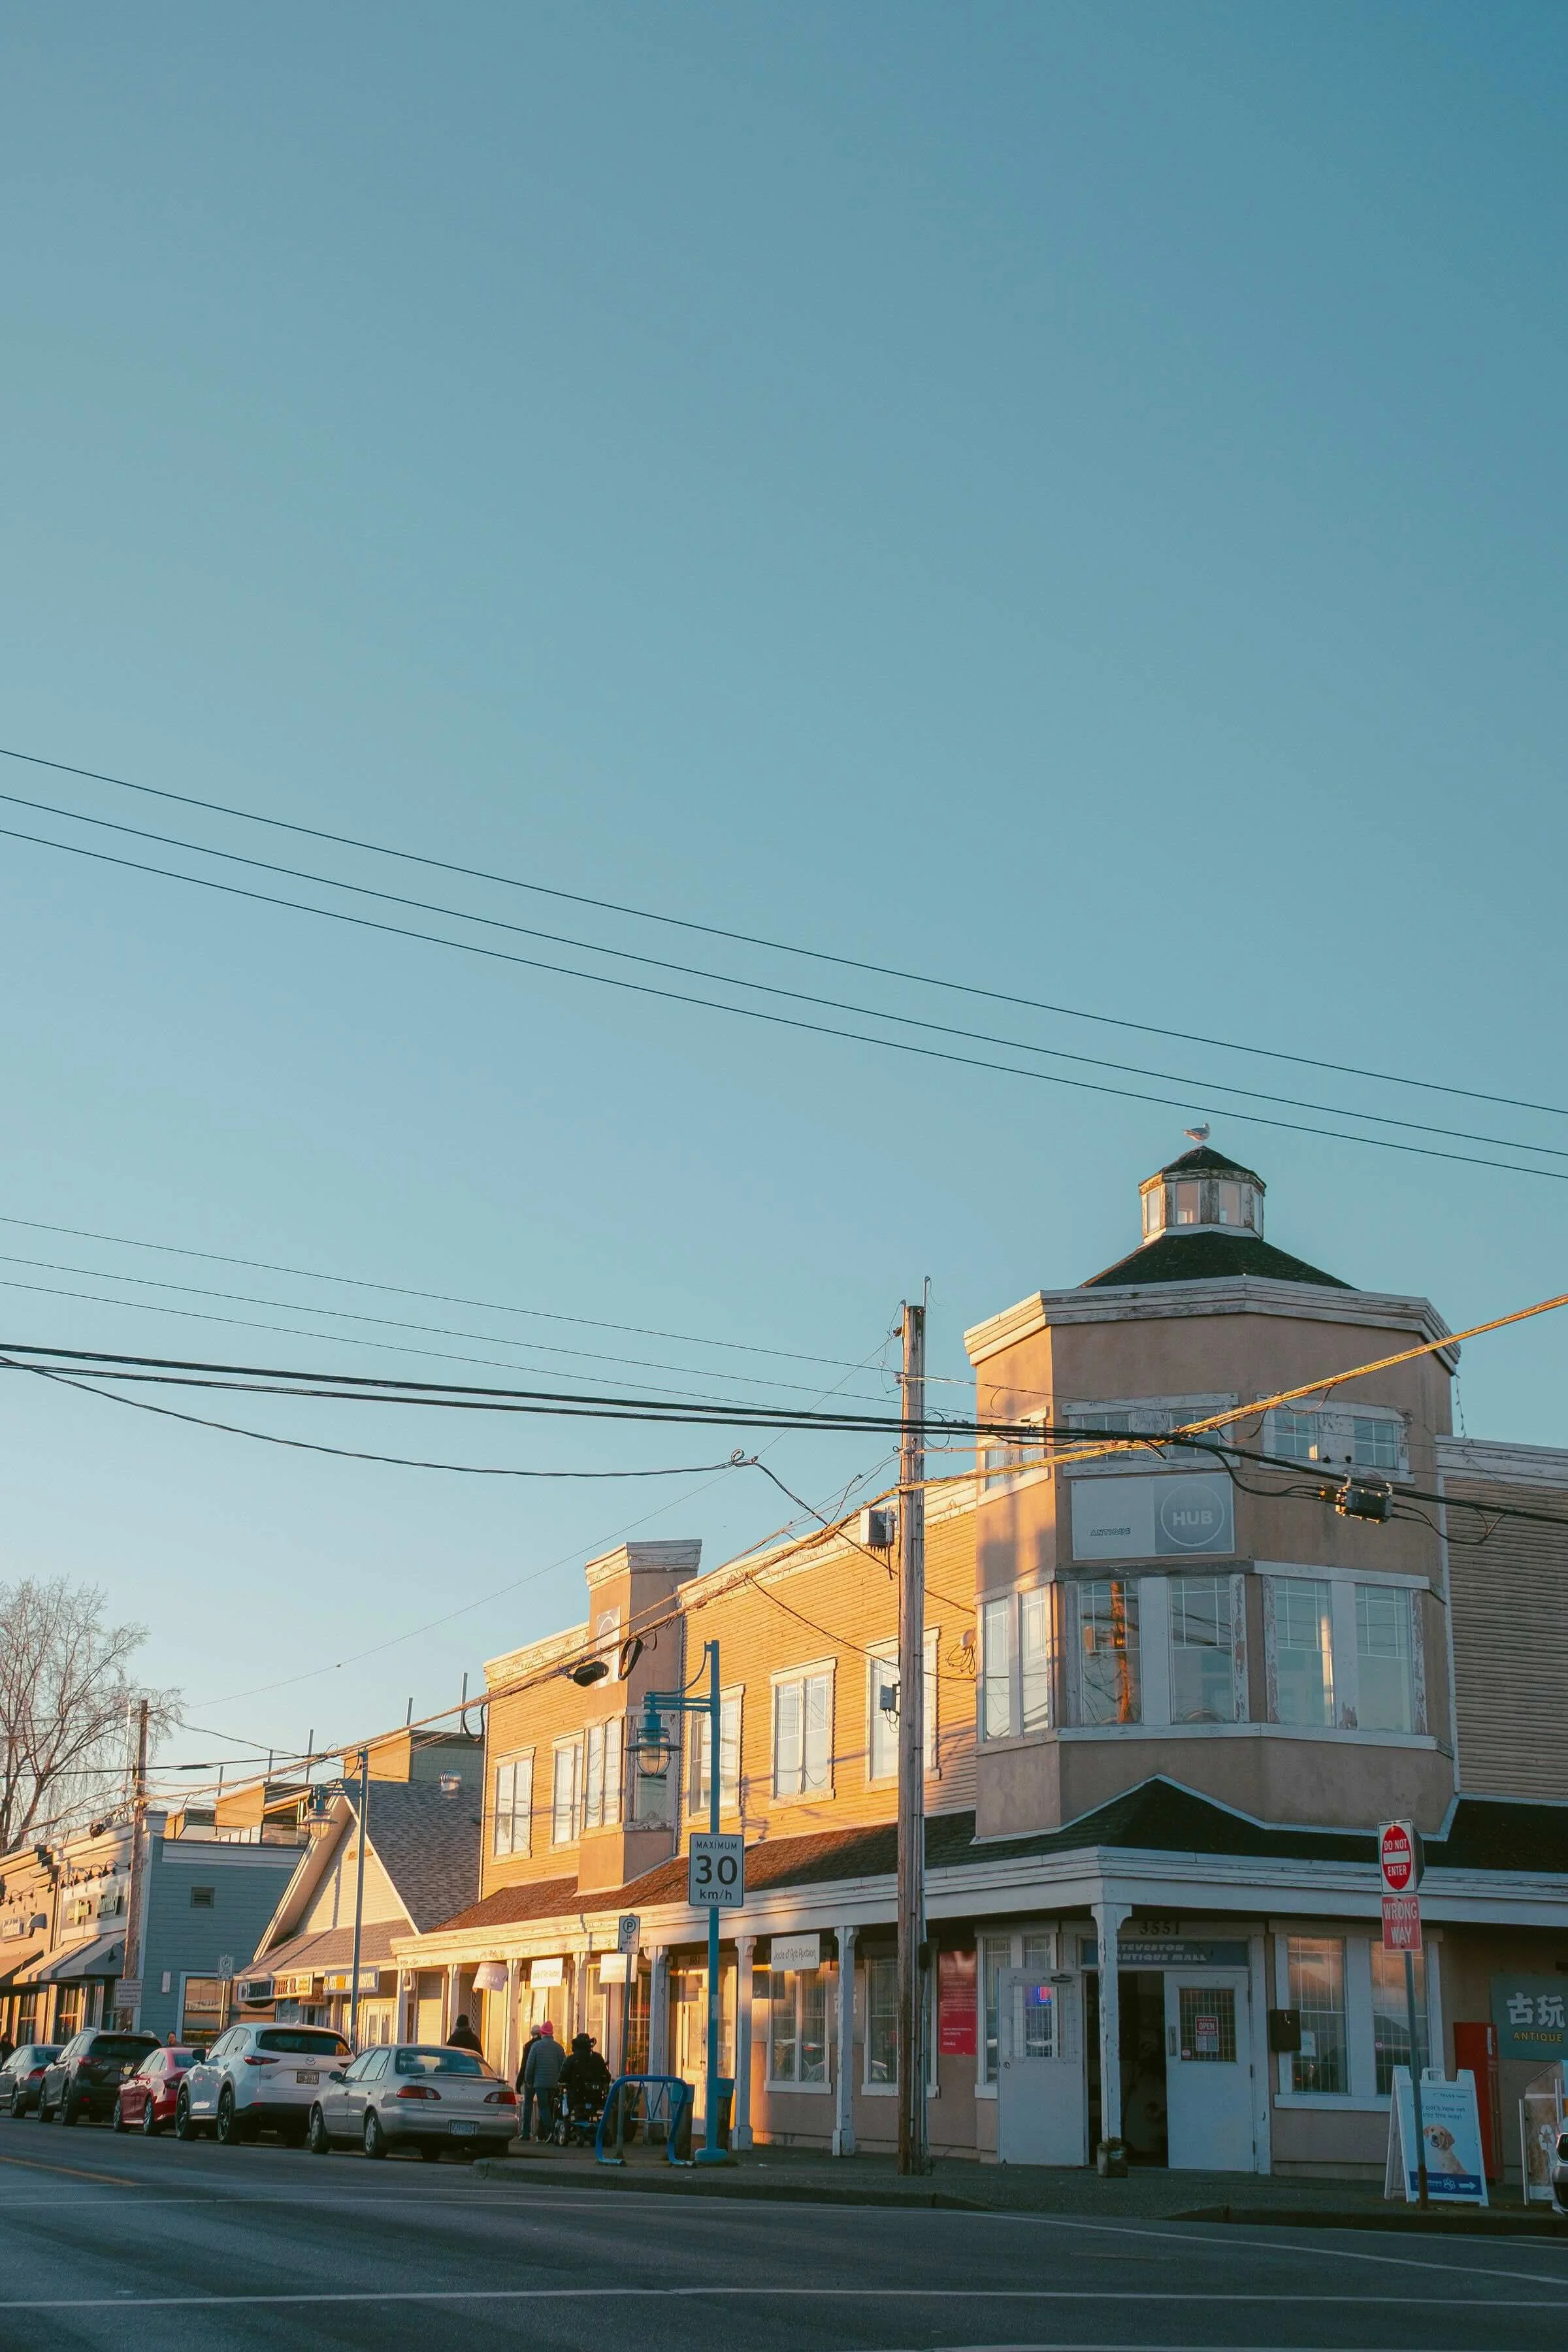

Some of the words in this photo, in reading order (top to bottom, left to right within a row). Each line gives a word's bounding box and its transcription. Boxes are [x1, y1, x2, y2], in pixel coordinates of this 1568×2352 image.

[1173, 1509, 1213, 1526] HUB
[1090, 1527, 1132, 1537] ANTIQUE
[696, 1840, 737, 1850] MAXIMUM
[1384, 1839, 1393, 1851] DO
[1395, 1838, 1407, 1850] NOT
[695, 1855, 738, 1885] 30
[1388, 1865, 1407, 1877] ENTER
[700, 1888, 732, 1900] km/h
[1383, 1901, 1417, 1920] WRONG
[1390, 1926, 1412, 1944] WAY
[1506, 1992, 1565, 2028] 古玩
[1513, 2033, 1562, 2042] ANTIQUE
